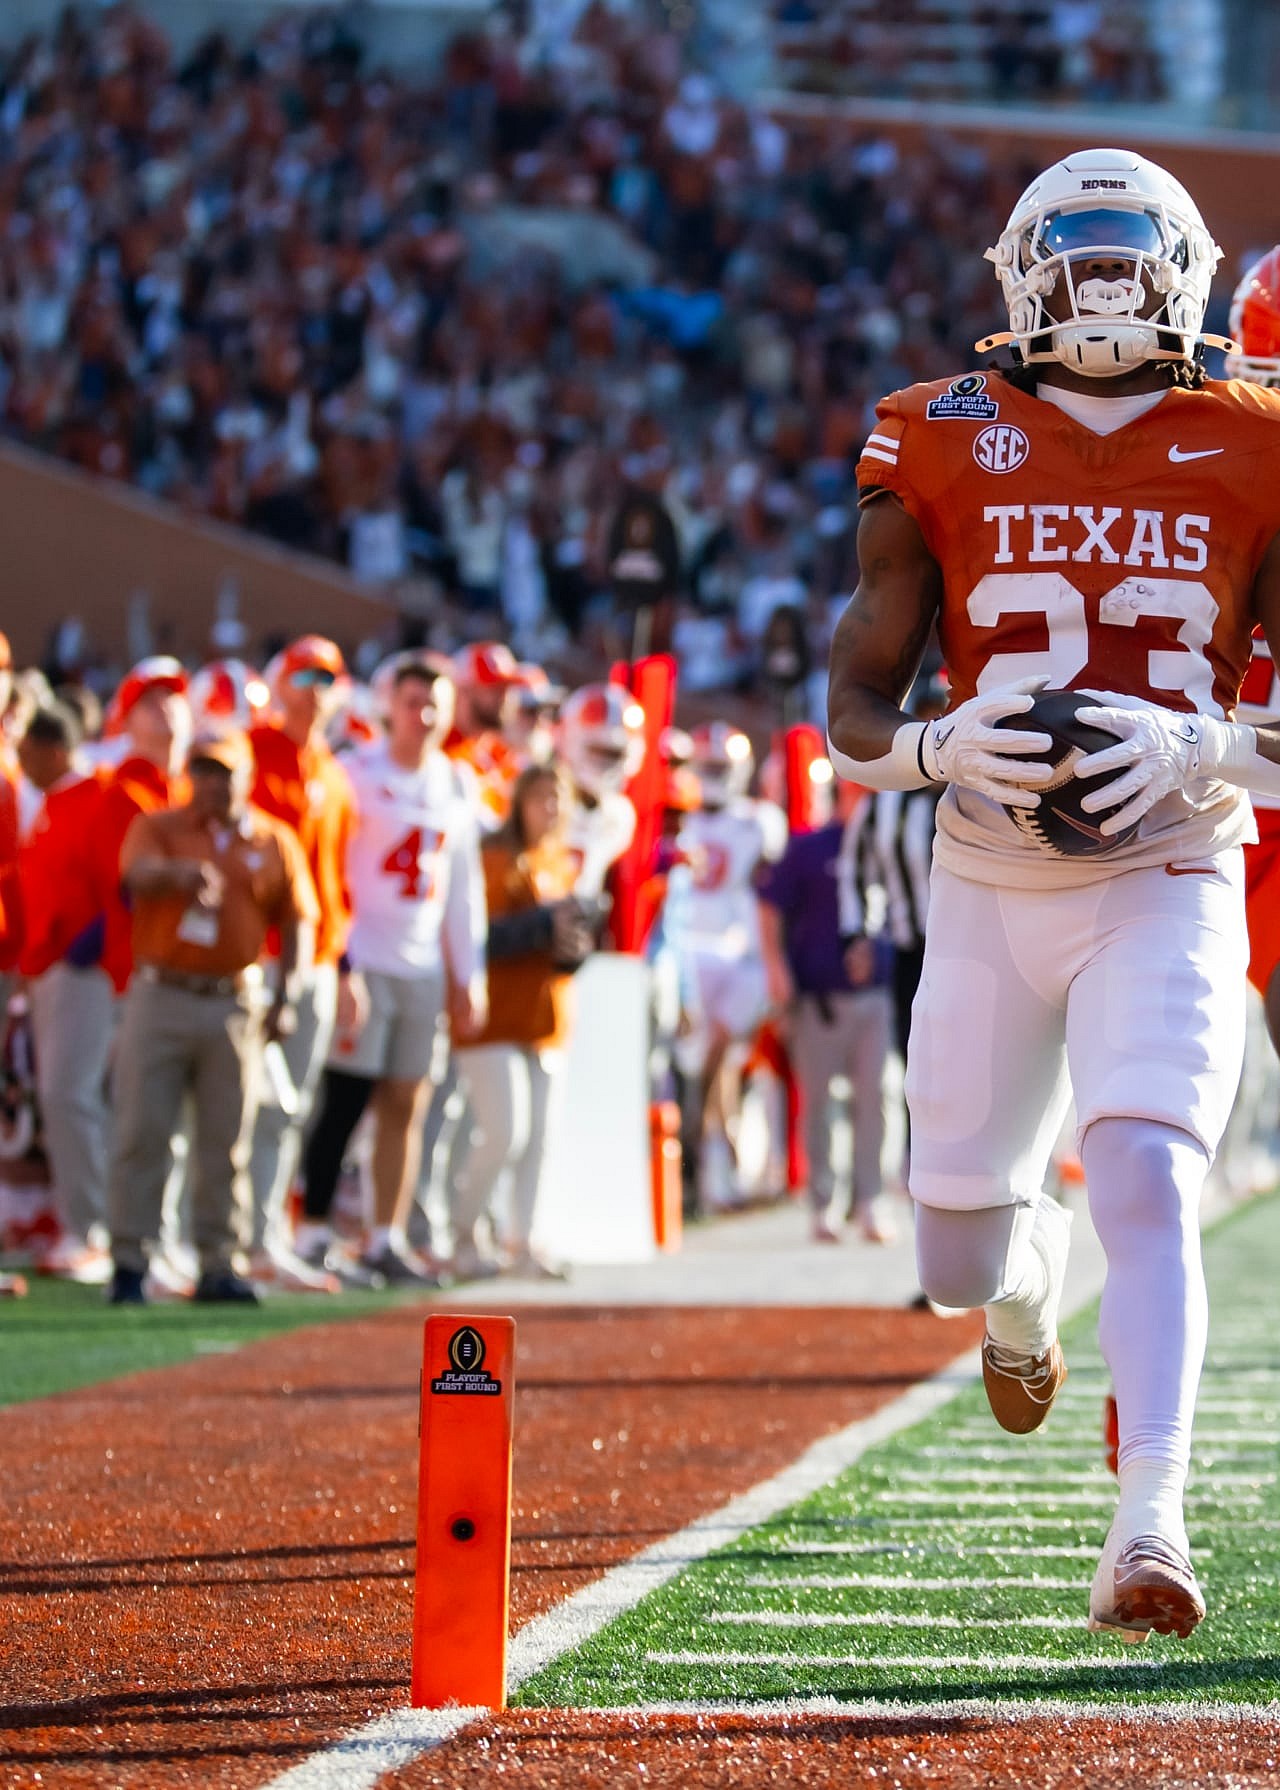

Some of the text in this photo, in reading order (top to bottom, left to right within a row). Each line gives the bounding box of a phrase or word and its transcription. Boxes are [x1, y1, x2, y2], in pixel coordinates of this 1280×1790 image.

[1081, 179, 1127, 190] HORNS
[931, 402, 995, 411] FIRST ROUND
[979, 427, 1025, 470] SEC
[983, 505, 1211, 572] TEXAS
[966, 571, 1226, 722] 23
[445, 1373, 488, 1382] PLAYOFF
[435, 1382, 498, 1392] FIRST ROUND
